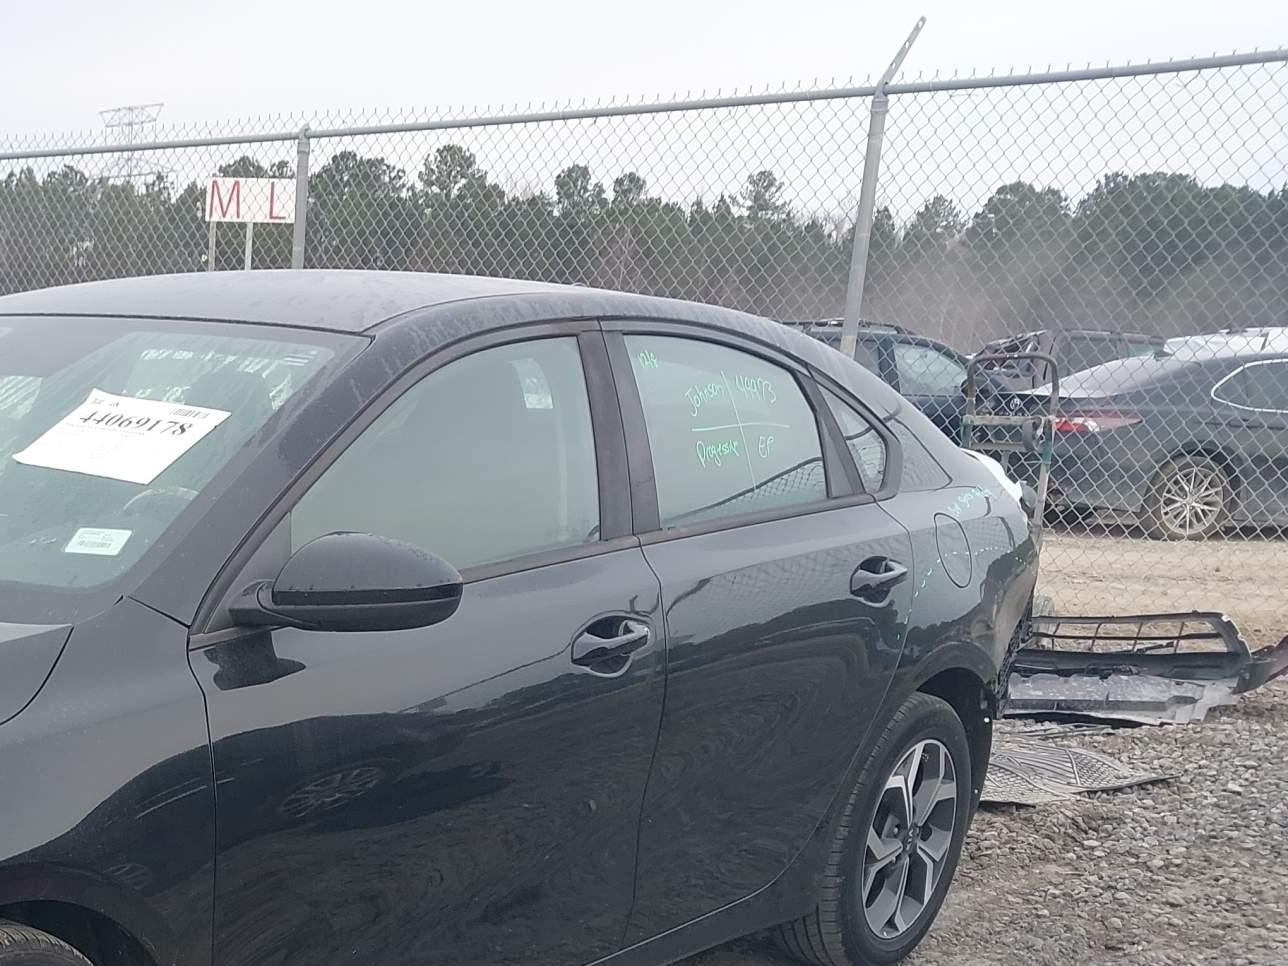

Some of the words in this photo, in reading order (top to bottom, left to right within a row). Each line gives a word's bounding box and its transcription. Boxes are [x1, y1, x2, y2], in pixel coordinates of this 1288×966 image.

[209, 180, 240, 219] M
[269, 181, 287, 220] L
[685, 383, 725, 417] Johnson
[79, 410, 194, 436] 44069178
